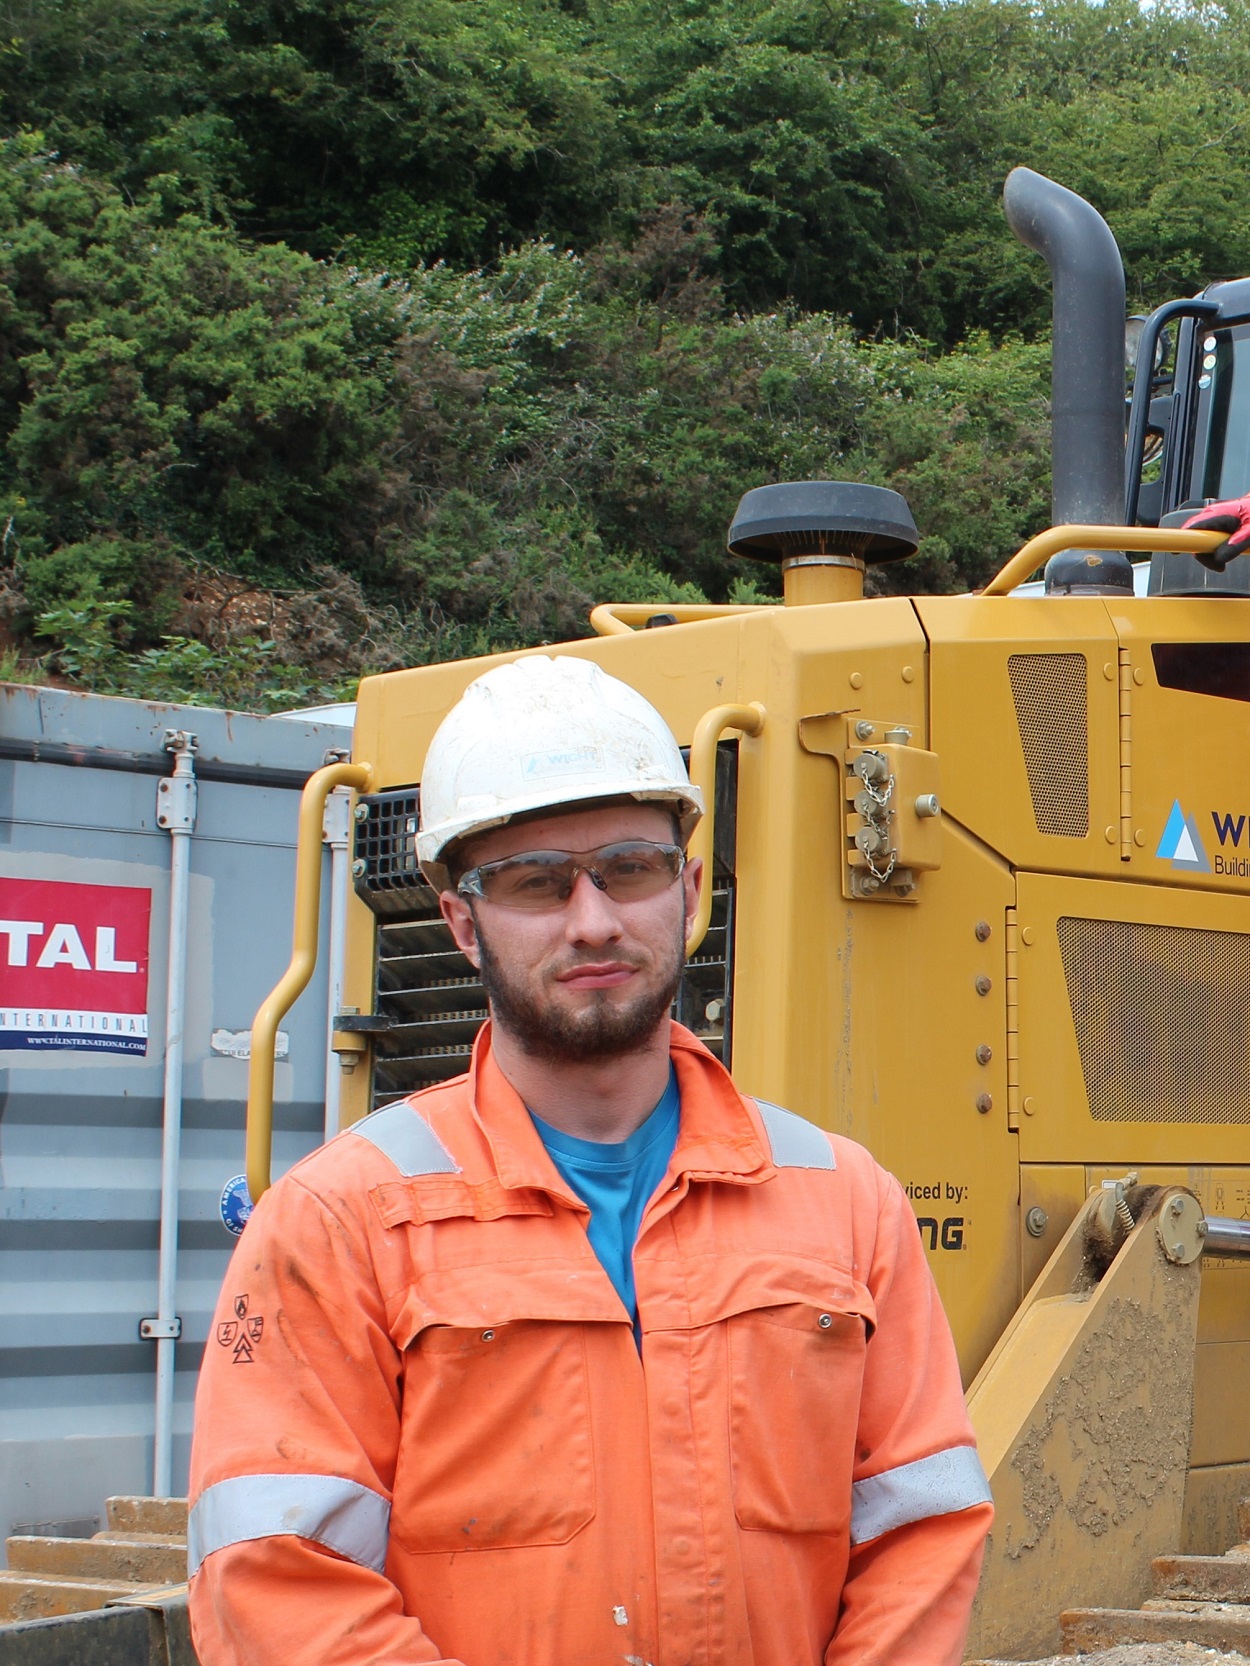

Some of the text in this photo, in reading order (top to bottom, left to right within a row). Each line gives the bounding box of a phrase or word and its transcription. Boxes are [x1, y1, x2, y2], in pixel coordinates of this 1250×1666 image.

[0, 919, 138, 974] TAL
[0, 1012, 147, 1033] NTERNATIONAL
[222, 1177, 247, 1206] AMERICA
[946, 1181, 968, 1205] by:
